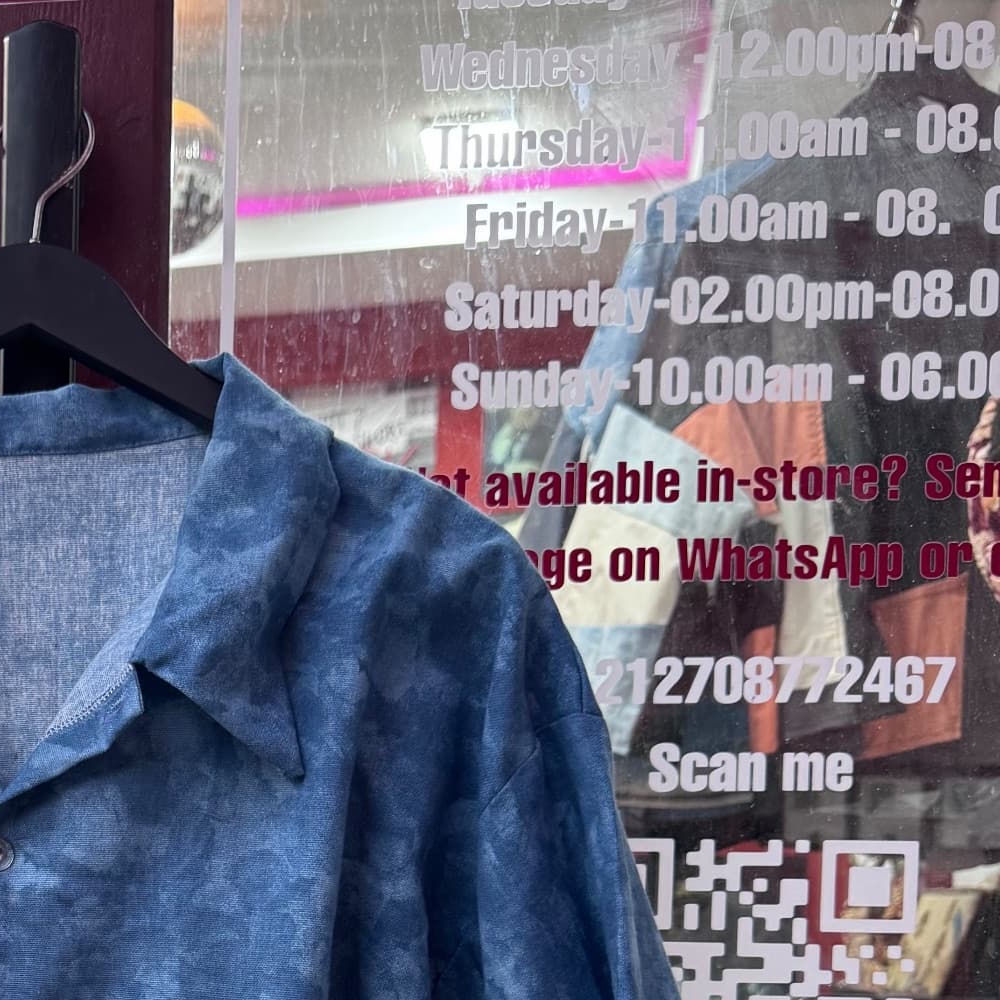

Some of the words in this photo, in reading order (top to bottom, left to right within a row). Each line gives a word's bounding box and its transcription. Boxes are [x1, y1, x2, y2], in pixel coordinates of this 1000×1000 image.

[420, 40, 680, 91] Wednesday
[916, 103, 1000, 154] 08.
[463, 194, 828, 254] Friday-11.00am
[451, 355, 833, 415] Sunday-10.00am
[485, 460, 681, 508] available
[696, 453, 908, 503] in-store?
[609, 545, 661, 583] on
[677, 534, 904, 588] WhatsApp
[919, 541, 973, 580] or
[594, 655, 957, 705] 212708772467
[648, 742, 768, 793] Scan
[782, 752, 854, 793] me
